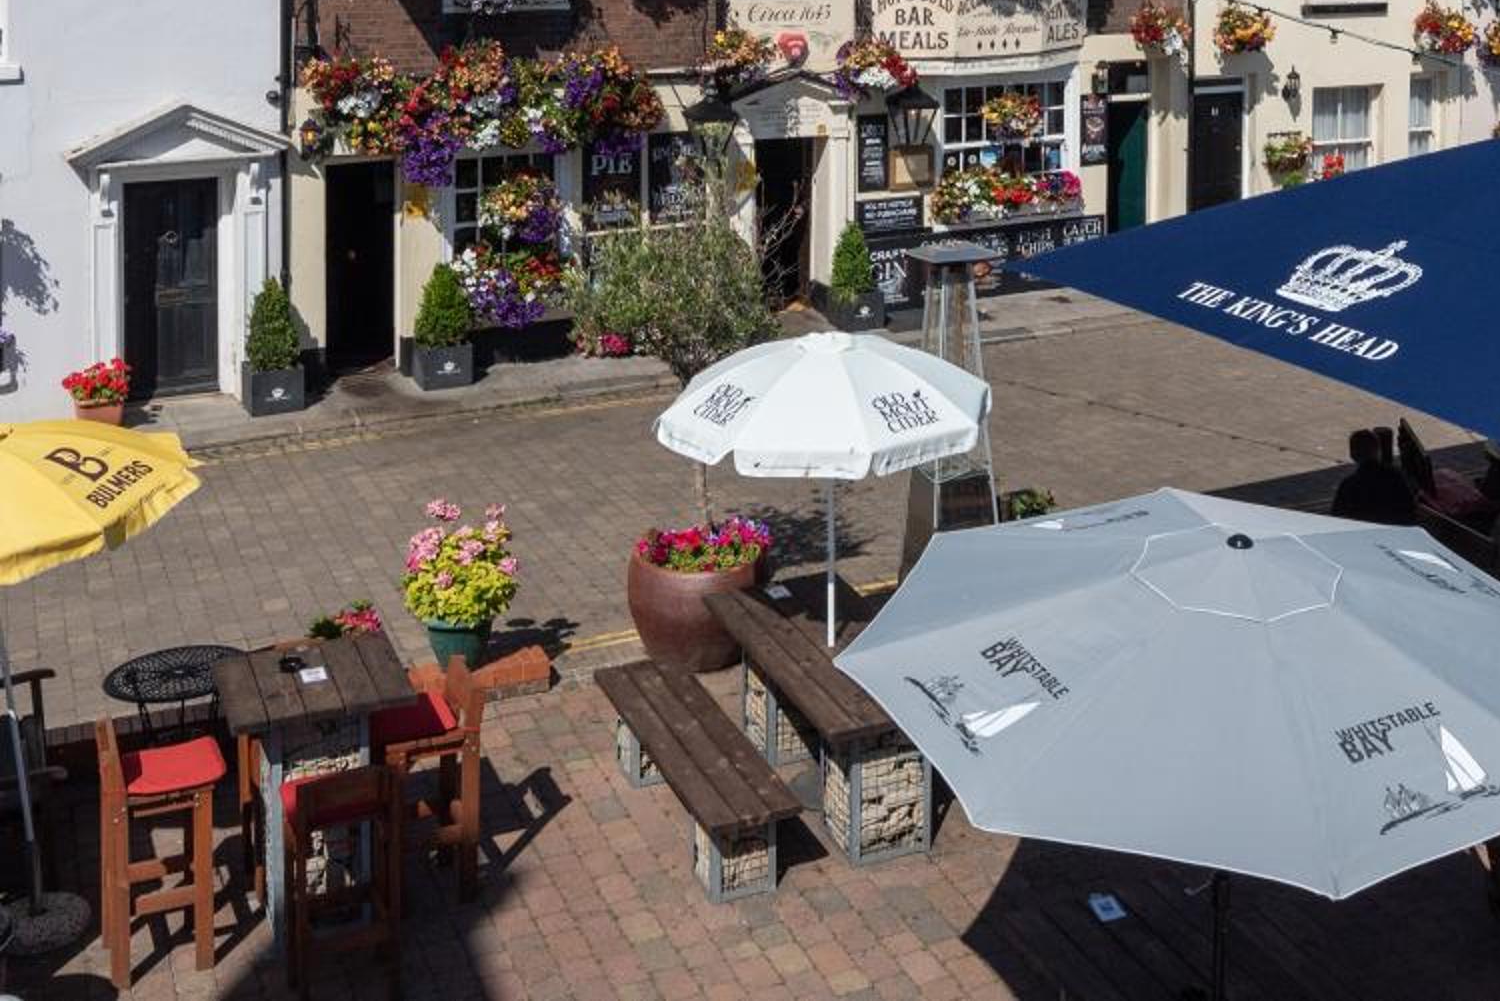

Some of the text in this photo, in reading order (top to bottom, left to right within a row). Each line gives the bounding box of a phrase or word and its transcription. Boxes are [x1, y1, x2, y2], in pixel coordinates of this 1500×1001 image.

[748, 1, 797, 23] Circa
[895, 6, 935, 26] BAR
[880, 30, 950, 50] MEALS
[1047, 23, 1080, 42] ALES
[591, 153, 633, 176] PIE
[1177, 282, 1399, 361] THE KING'S HEAD
[86, 460, 154, 509] BULMERS
[980, 641, 1027, 678] BAY
[1334, 701, 1440, 742] WHITSTABLE
[1339, 729, 1394, 763] BAY
